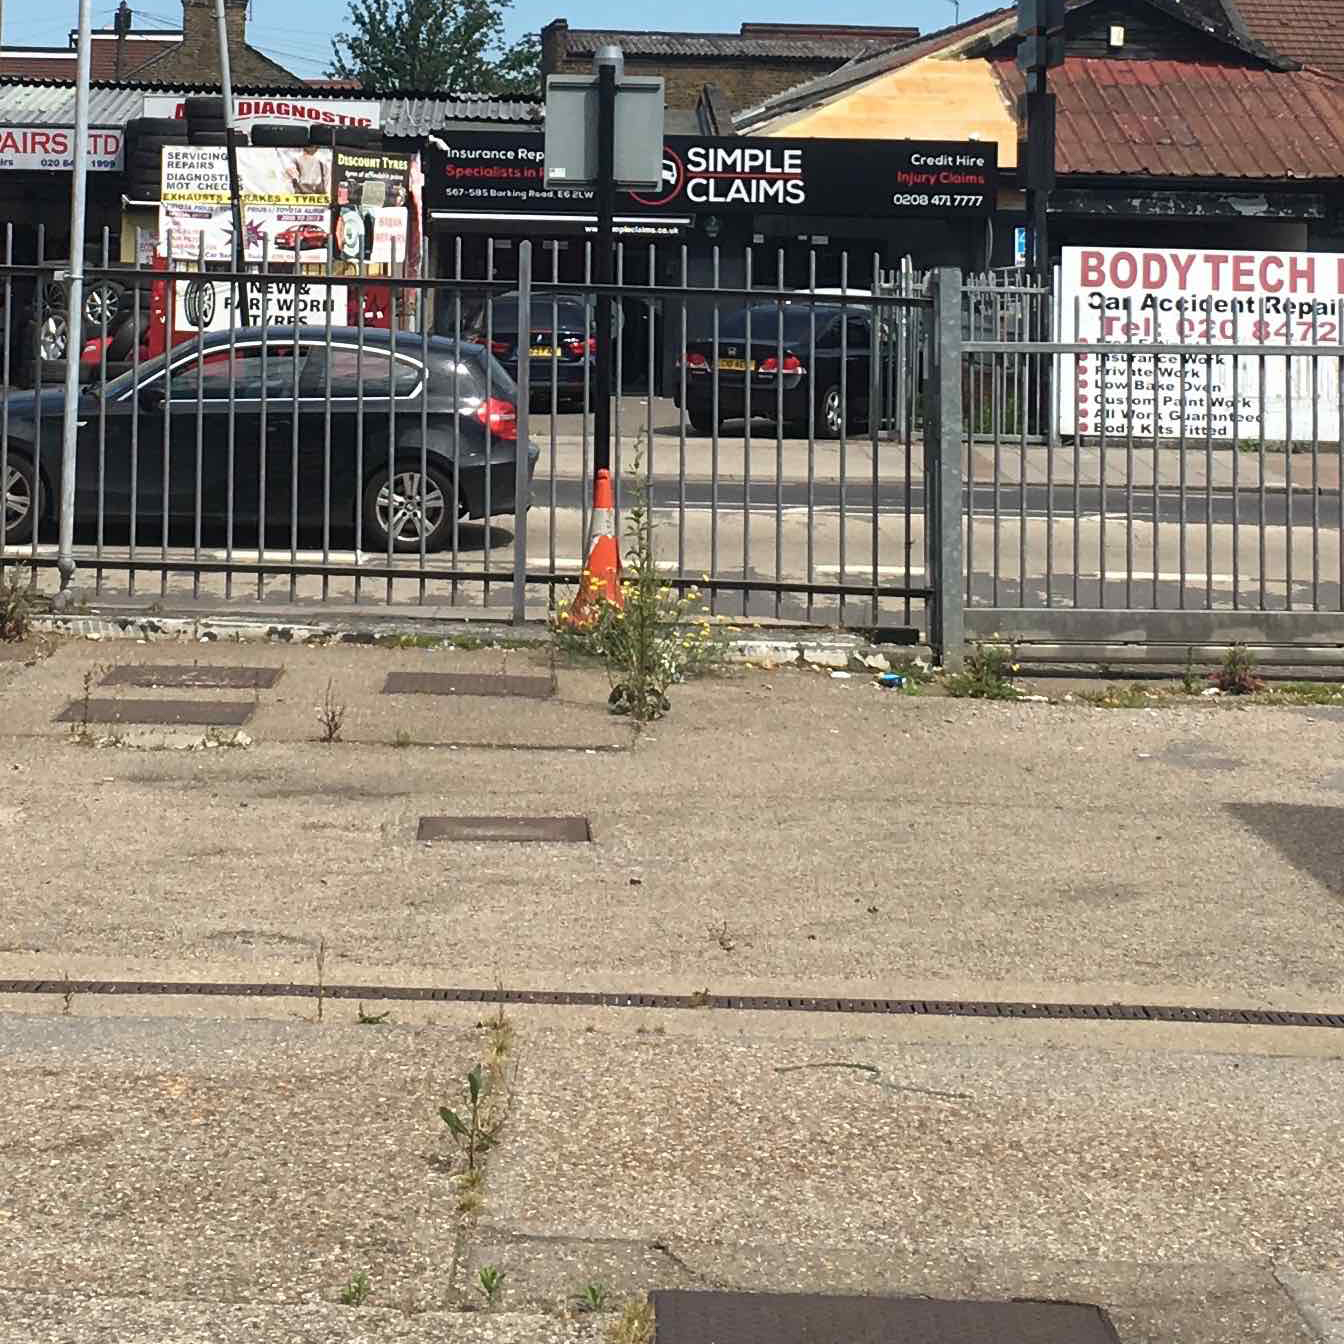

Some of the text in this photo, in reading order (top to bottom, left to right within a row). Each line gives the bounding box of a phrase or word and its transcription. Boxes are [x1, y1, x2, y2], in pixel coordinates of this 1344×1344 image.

[238, 100, 372, 128] DIAGNOSTIC
[87, 133, 120, 156] TD
[167, 151, 229, 162] SERVICING
[447, 147, 545, 162] Insurance Rep
[687, 147, 803, 173] SIMPLE
[911, 153, 985, 167] Credit Hire
[40, 158, 59, 168] 020
[167, 160, 215, 170] REPAIRS
[166, 172, 243, 183] DIAGNOSTIS
[446, 163, 521, 179] Specialists
[524, 165, 537, 177] in
[896, 171, 985, 186] Injury Claims
[166, 181, 244, 192] MOT CHECS
[445, 187, 489, 197] 567-585
[489, 188, 528, 200] Barking
[557, 188, 570, 198] E6
[571, 189, 594, 199] 2LW
[686, 178, 805, 204] CLAIMS
[163, 192, 223, 202] EXHAUSTS
[294, 194, 329, 204] TYRES
[893, 193, 984, 207] 0208 471 7777
[1080, 251, 1197, 290] BODY
[1203, 254, 1316, 293] TECH
[249, 280, 311, 295] NEW &
[224, 297, 274, 310] PRT
[1088, 291, 1130, 311] Car
[1140, 293, 1255, 314] Accident
[1175, 317, 1238, 340] 020
[1252, 320, 1337, 341] 8472
[1183, 354, 1225, 366] Work
[1158, 367, 1200, 378] Work
[1094, 380, 1129, 390] Low
[1134, 380, 1175, 392] Bake
[1094, 394, 1156, 405] Cusom
[1210, 397, 1252, 409] Work
[1093, 408, 1115, 419] All
[1121, 409, 1163, 421] Work
[1140, 424, 1174, 435] Kts
